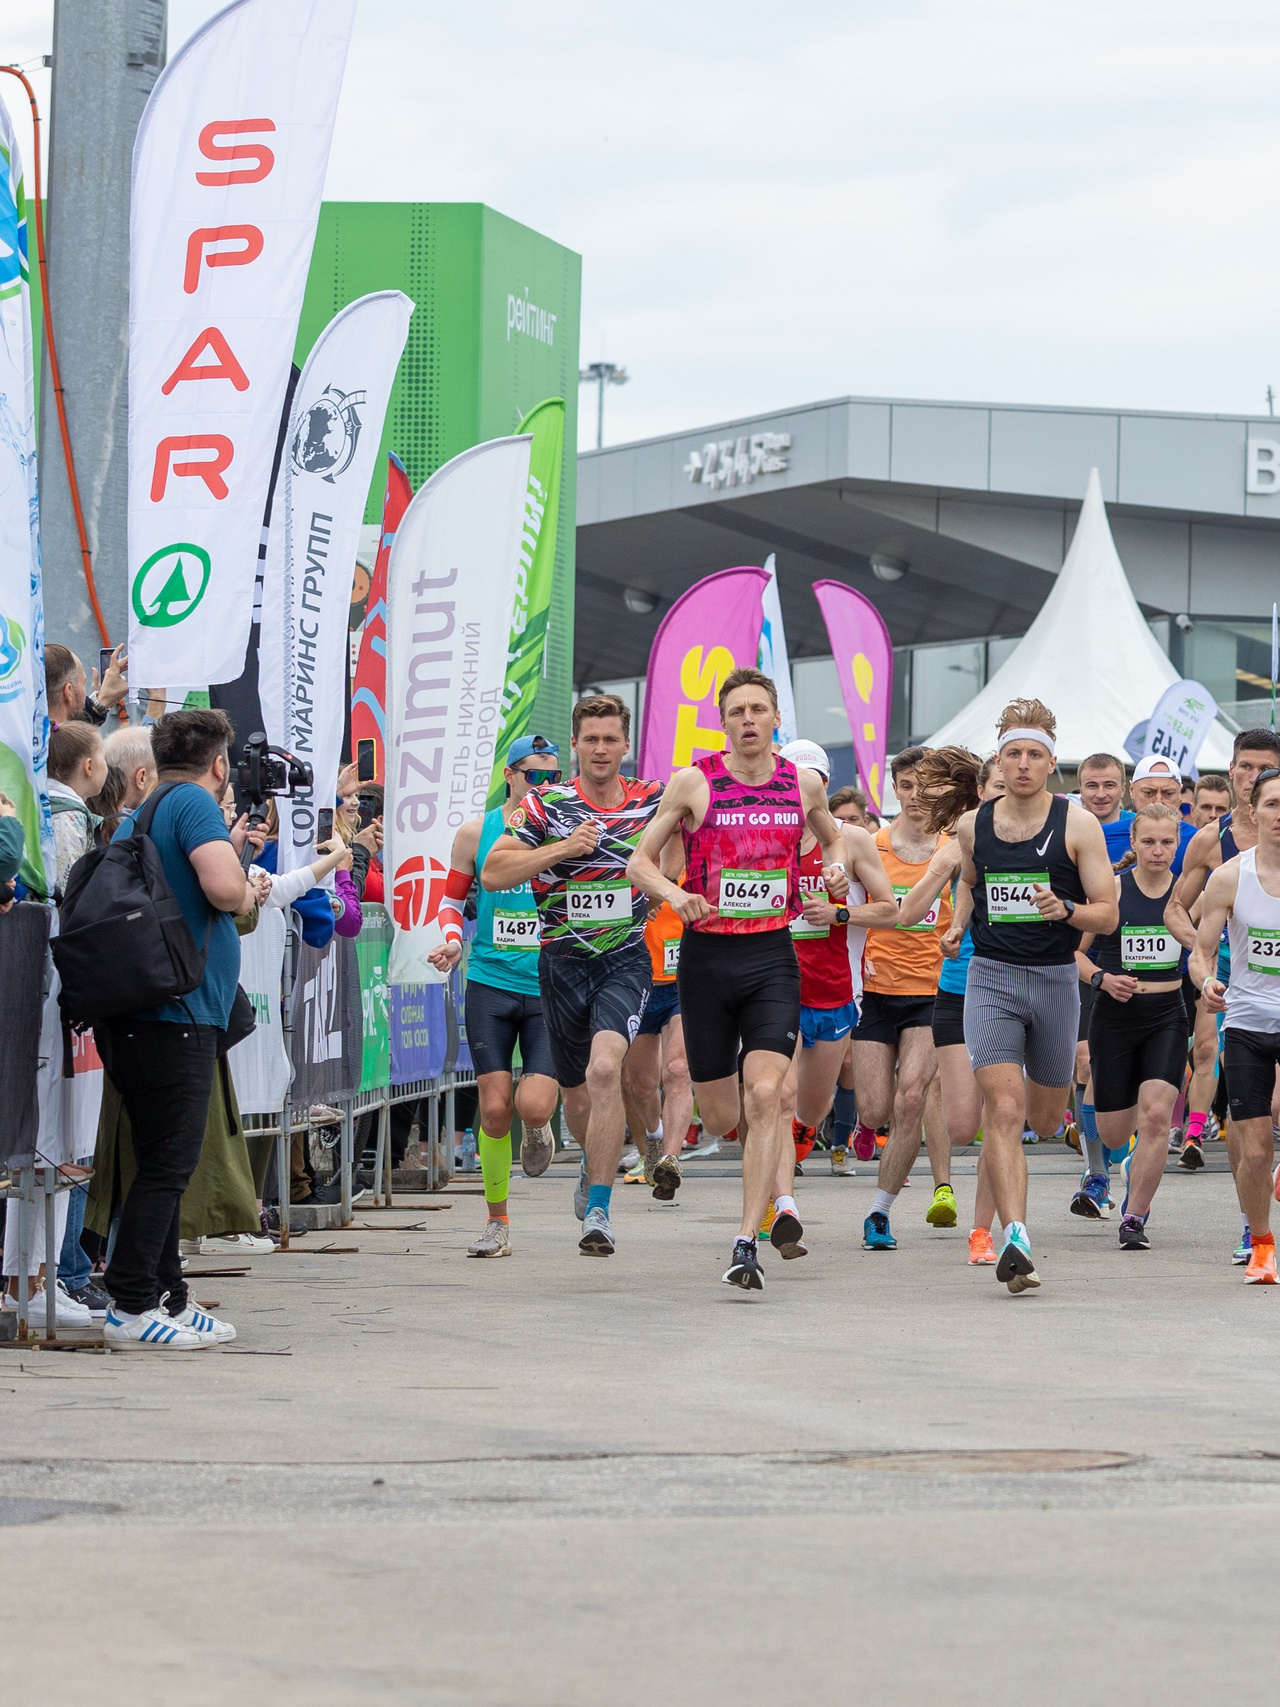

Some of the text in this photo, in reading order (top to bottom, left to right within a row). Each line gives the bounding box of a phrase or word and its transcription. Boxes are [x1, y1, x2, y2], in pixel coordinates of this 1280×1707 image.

[150, 117, 276, 502] SPAR
[507, 286, 557, 347] рейтинг
[301, 511, 333, 613] ГРУПП
[294, 618, 319, 753] МАРИНС
[395, 567, 459, 834] azimut
[446, 621, 482, 828] ОТЕЛЬ НИЖНИЙ
[715, 812, 799, 826] JUST GO RUN
[725, 882, 771, 899] 0649
[990, 886, 1032, 903] 0544
[571, 893, 615, 909] 0219
[773, 896, 782, 907] A
[497, 920, 537, 935] 1487
[1126, 937, 1166, 952] 1310
